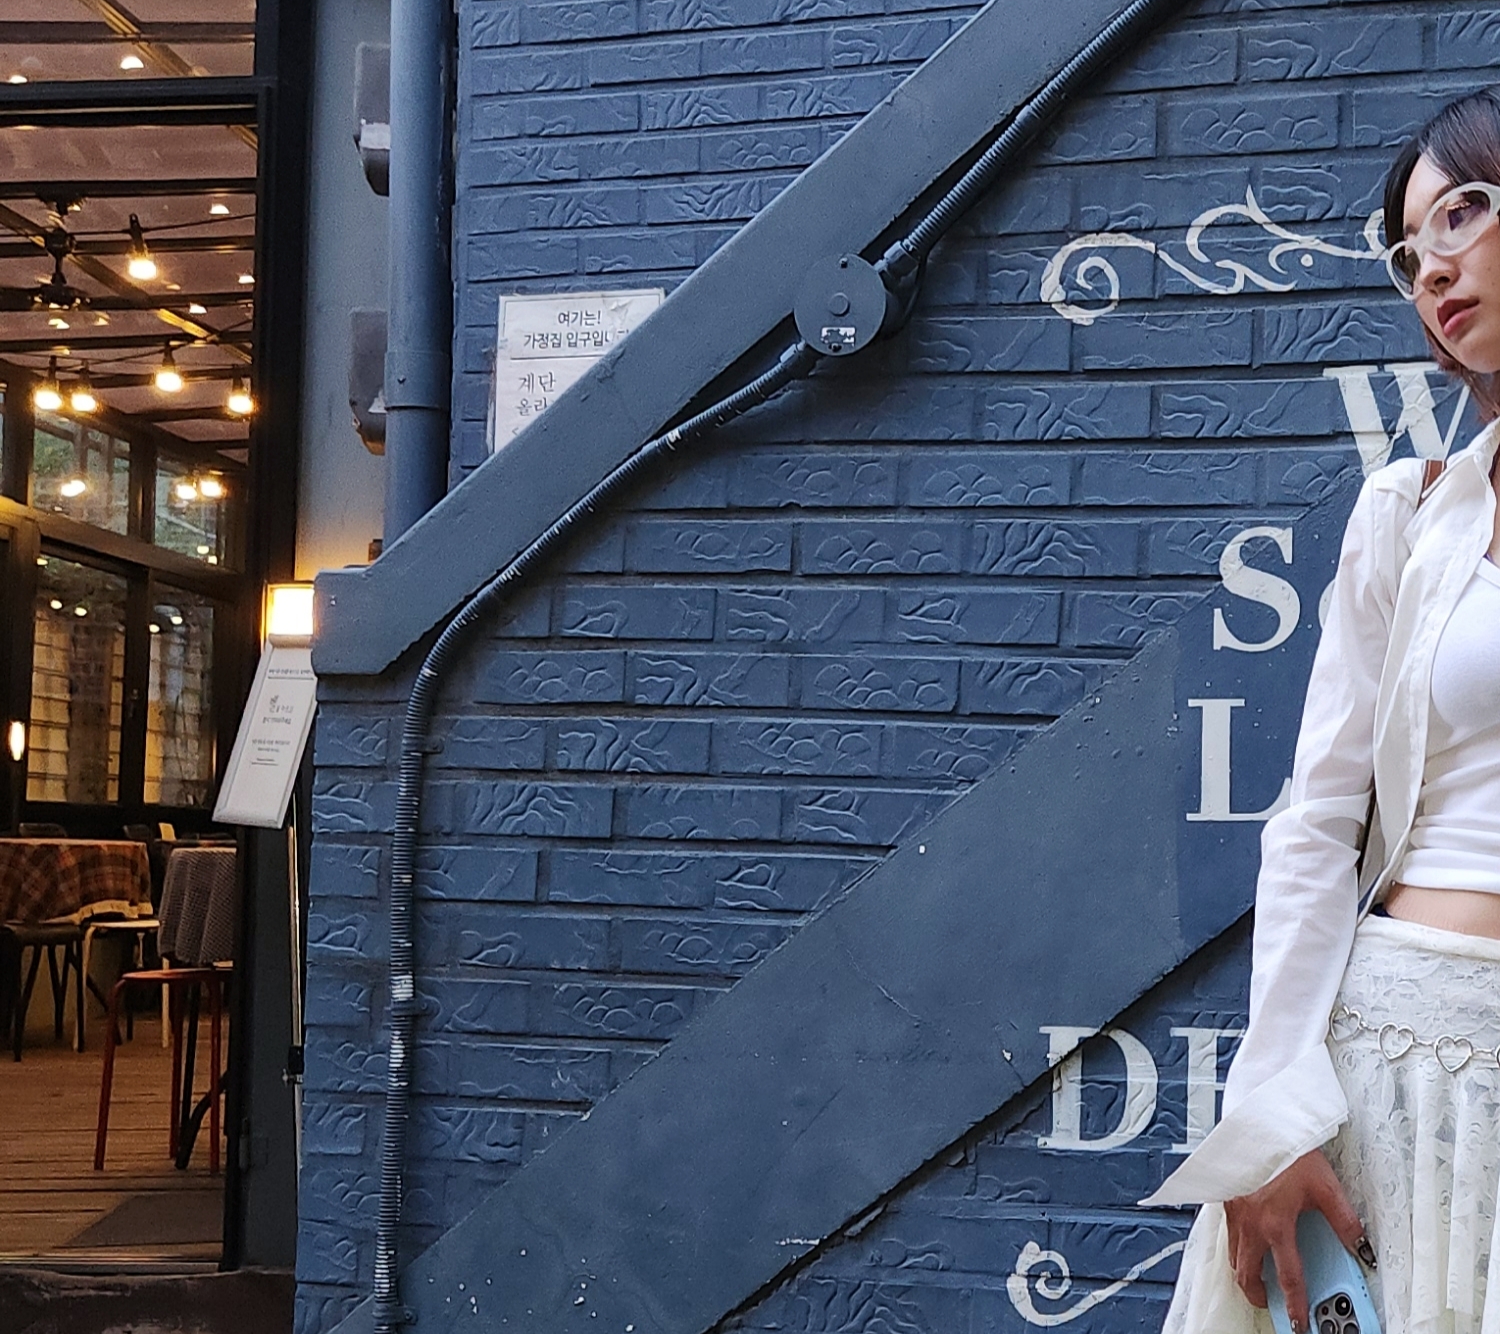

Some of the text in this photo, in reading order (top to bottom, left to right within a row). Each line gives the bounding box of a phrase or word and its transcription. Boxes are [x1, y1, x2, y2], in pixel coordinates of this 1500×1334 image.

[557, 309, 602, 327] 여기는!
[523, 328, 629, 350] 가정집 입구입
[517, 371, 556, 394] 계단
